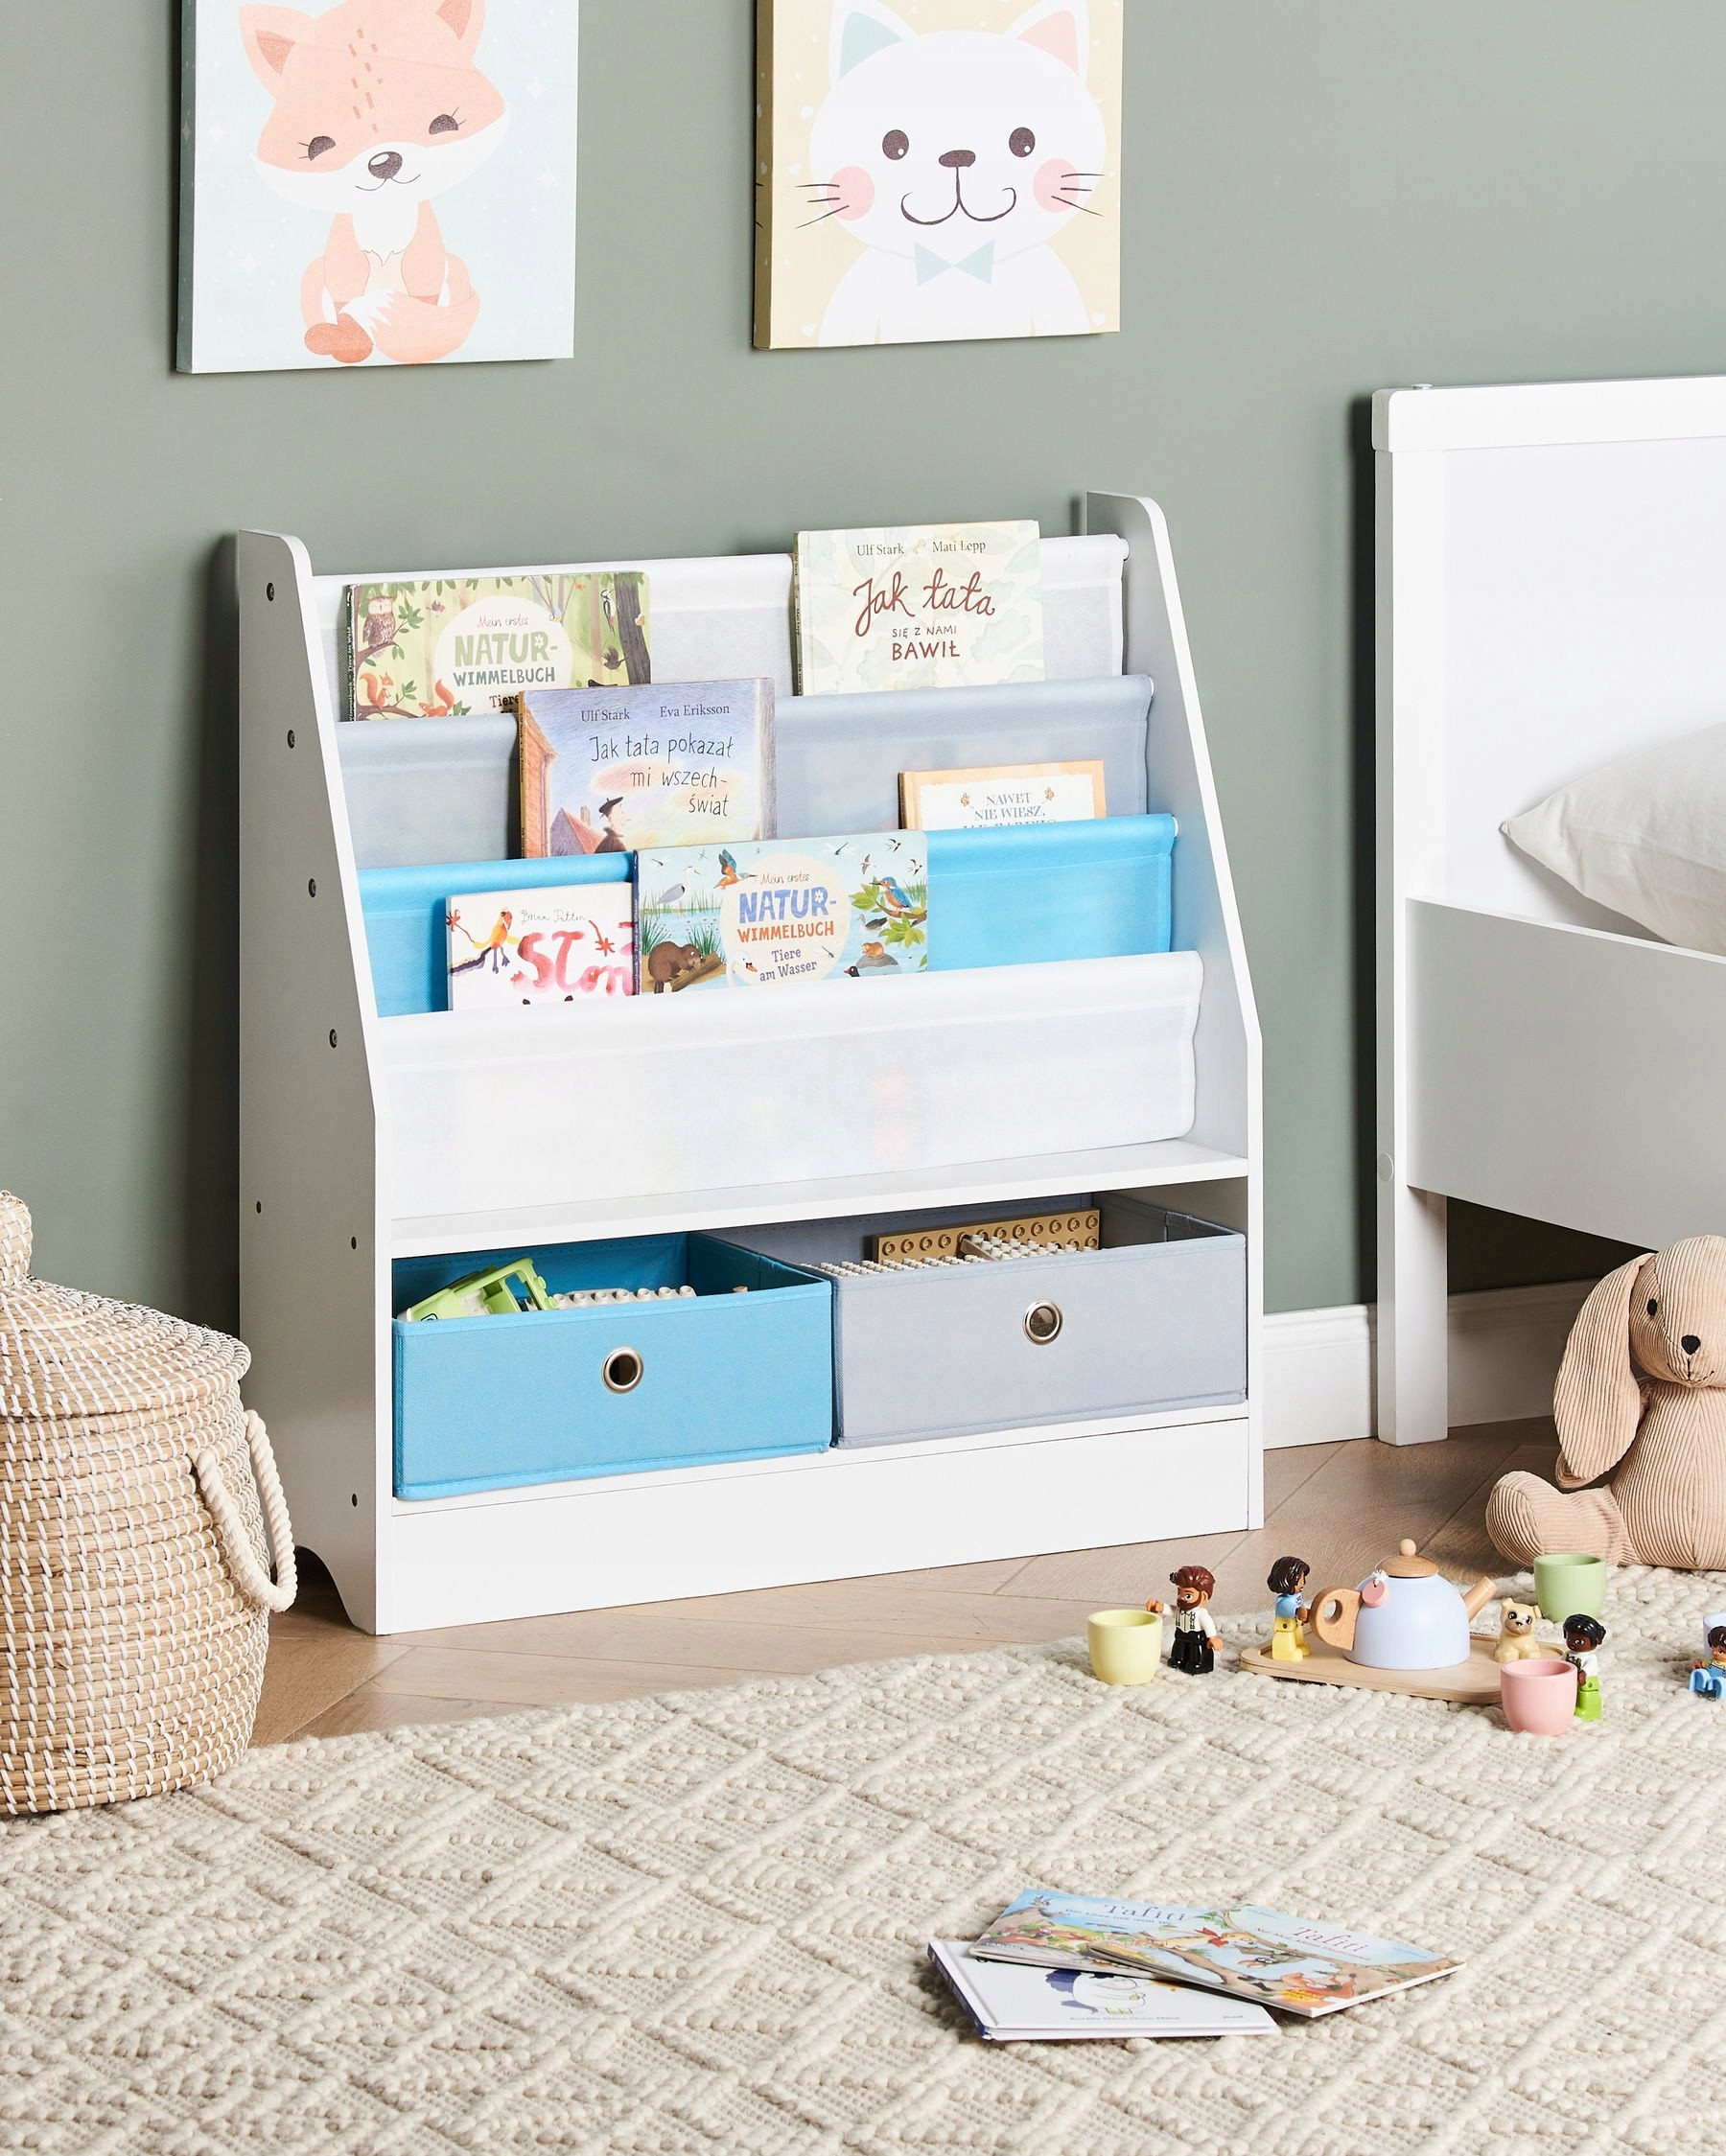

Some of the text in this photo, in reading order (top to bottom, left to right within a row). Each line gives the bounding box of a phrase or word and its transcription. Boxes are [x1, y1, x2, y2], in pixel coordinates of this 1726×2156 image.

[857, 544, 903, 555] Ulf Stark
[932, 541, 986, 553] Mati Lepp
[853, 568, 995, 637] Jak tata
[477, 615, 528, 628] Mein erstes
[892, 628, 908, 638] SIĘ
[455, 632, 558, 667] NATUR-
[892, 640, 961, 661] BAWIŁ
[453, 667, 555, 686] WIMMELBUCH
[489, 693, 519, 708] Tiere
[581, 708, 630, 722] Ulf Stark
[661, 705, 730, 717] Eva Eriksson
[589, 732, 734, 763] Jak tata pokazał
[631, 767, 727, 787] mi wszech-
[688, 794, 728, 817] świat
[987, 793, 1031, 805] NAWET
[975, 806, 1045, 821] NIE WIESZ,
[760, 872, 809, 884] Mein erstes
[739, 887, 837, 924] NATUR-
[737, 920, 834, 943] WIMMELBUCH
[771, 947, 801, 962] Tiere
[759, 961, 817, 982] am Wasser
[1105, 1904, 1187, 1922] Tafiti
[1293, 1926, 1368, 1952] Tafiti
